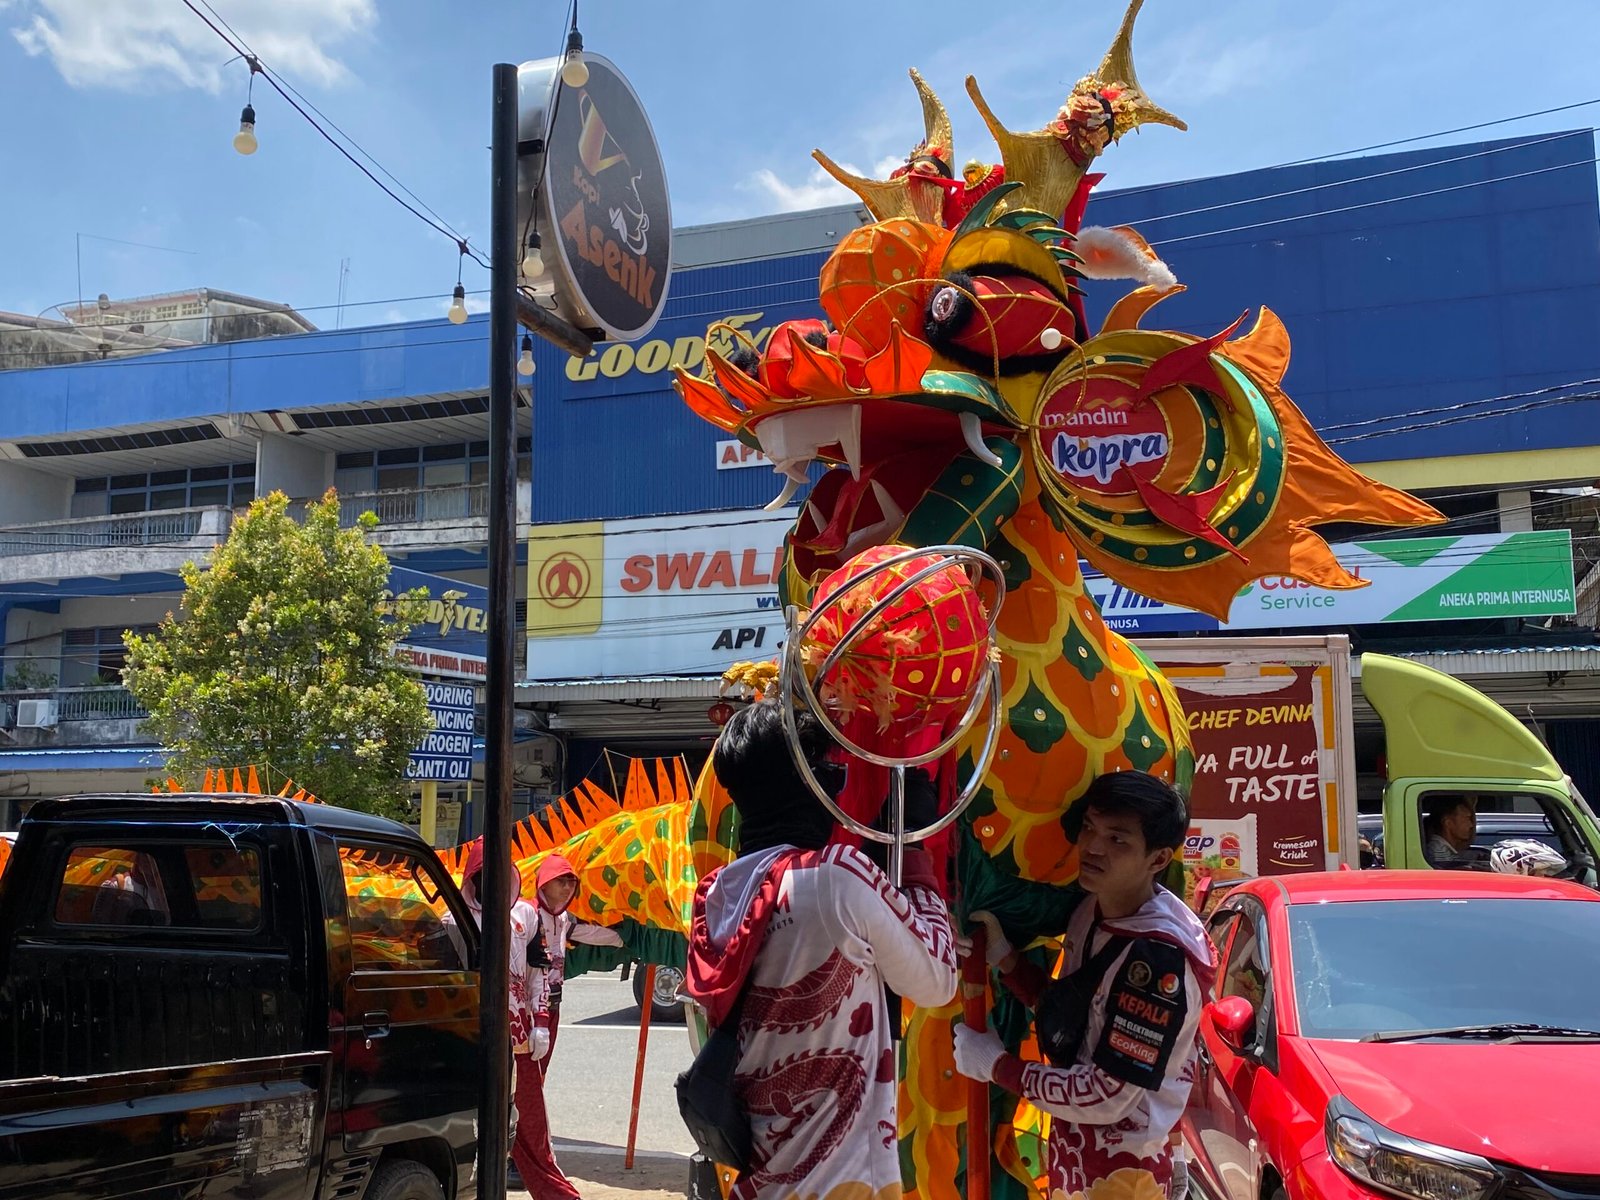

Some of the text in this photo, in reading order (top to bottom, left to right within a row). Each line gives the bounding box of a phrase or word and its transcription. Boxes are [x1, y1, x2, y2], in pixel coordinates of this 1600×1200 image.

[560, 199, 656, 309] Asenk
[1044, 407, 1128, 428] mandiri
[1057, 434, 1162, 479] kopra
[1260, 592, 1336, 610] Service
[1439, 588, 1571, 607] ANEKA PRIMA INTERNUSA
[712, 626, 766, 650] API
[1187, 703, 1313, 730] CHEF DEVINA
[449, 760, 469, 778] OLI
[1228, 743, 1294, 770] FULL
[1300, 750, 1318, 765] of
[1225, 773, 1319, 803] TASTE
[1273, 838, 1318, 849] Kremesan
[1280, 850, 1309, 860] Kriuk
[1118, 993, 1169, 1026] KEPALA
[1111, 1034, 1155, 1063] EcoKing
